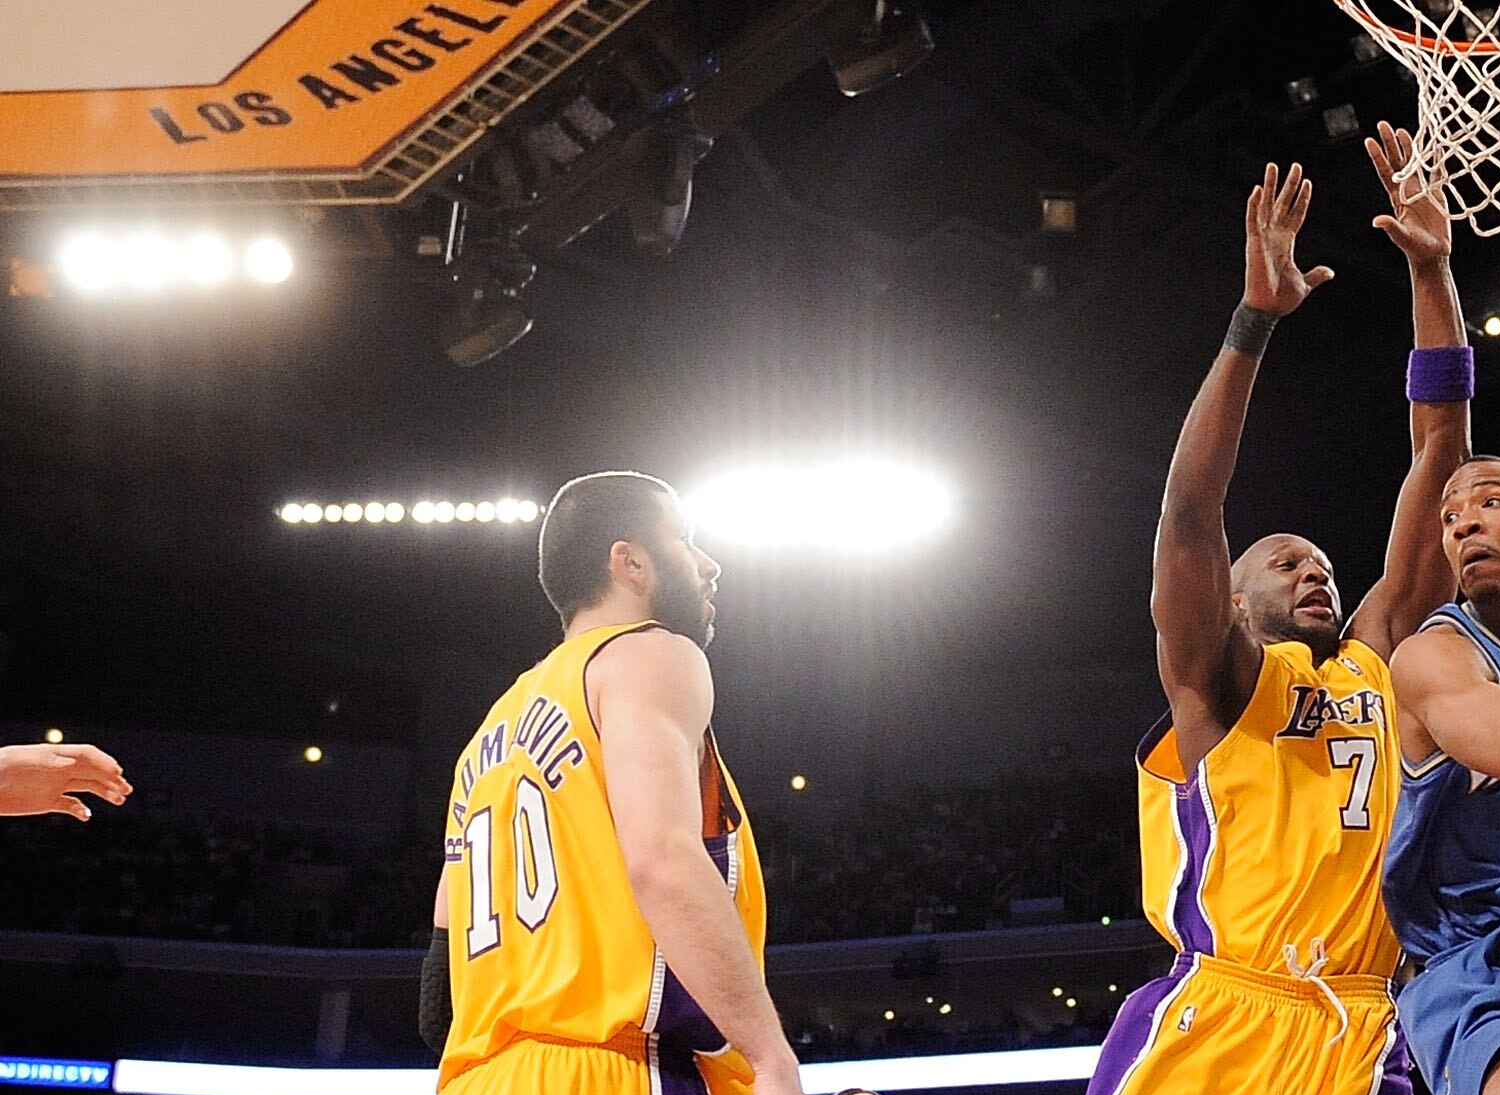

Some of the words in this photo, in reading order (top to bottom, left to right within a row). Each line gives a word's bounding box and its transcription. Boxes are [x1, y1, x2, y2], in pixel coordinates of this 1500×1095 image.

[148, 90, 293, 145] LOS
[298, 0, 525, 109] ANGEL
[446, 696, 584, 862] RADMOVIC
[1277, 686, 1387, 739] LAKER
[1326, 737, 1378, 830] 7
[463, 773, 559, 961] 10
